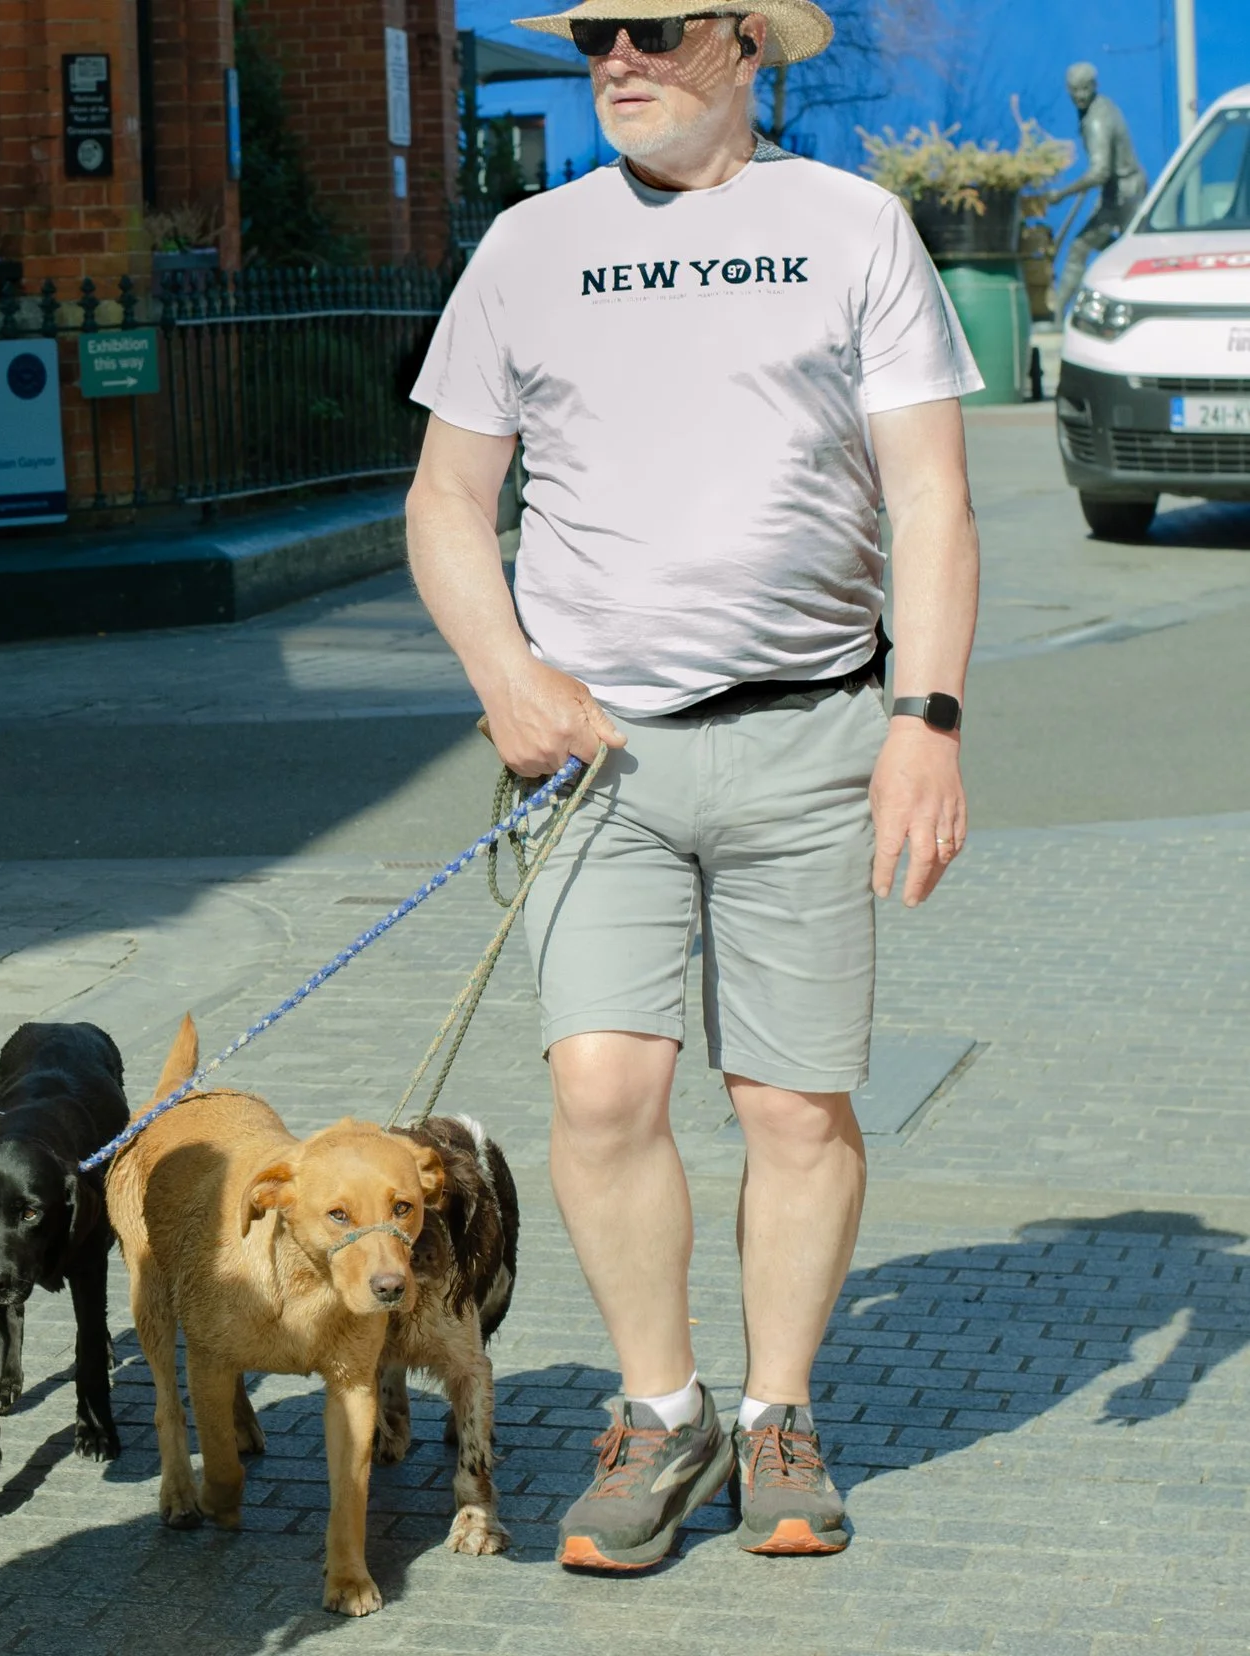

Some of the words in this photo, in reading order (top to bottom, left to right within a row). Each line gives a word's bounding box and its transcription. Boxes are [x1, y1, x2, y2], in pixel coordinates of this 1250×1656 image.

[581, 259, 680, 296] NEW
[87, 336, 149, 355] Exhibition
[93, 356, 117, 372] this
[117, 356, 145, 373] way
